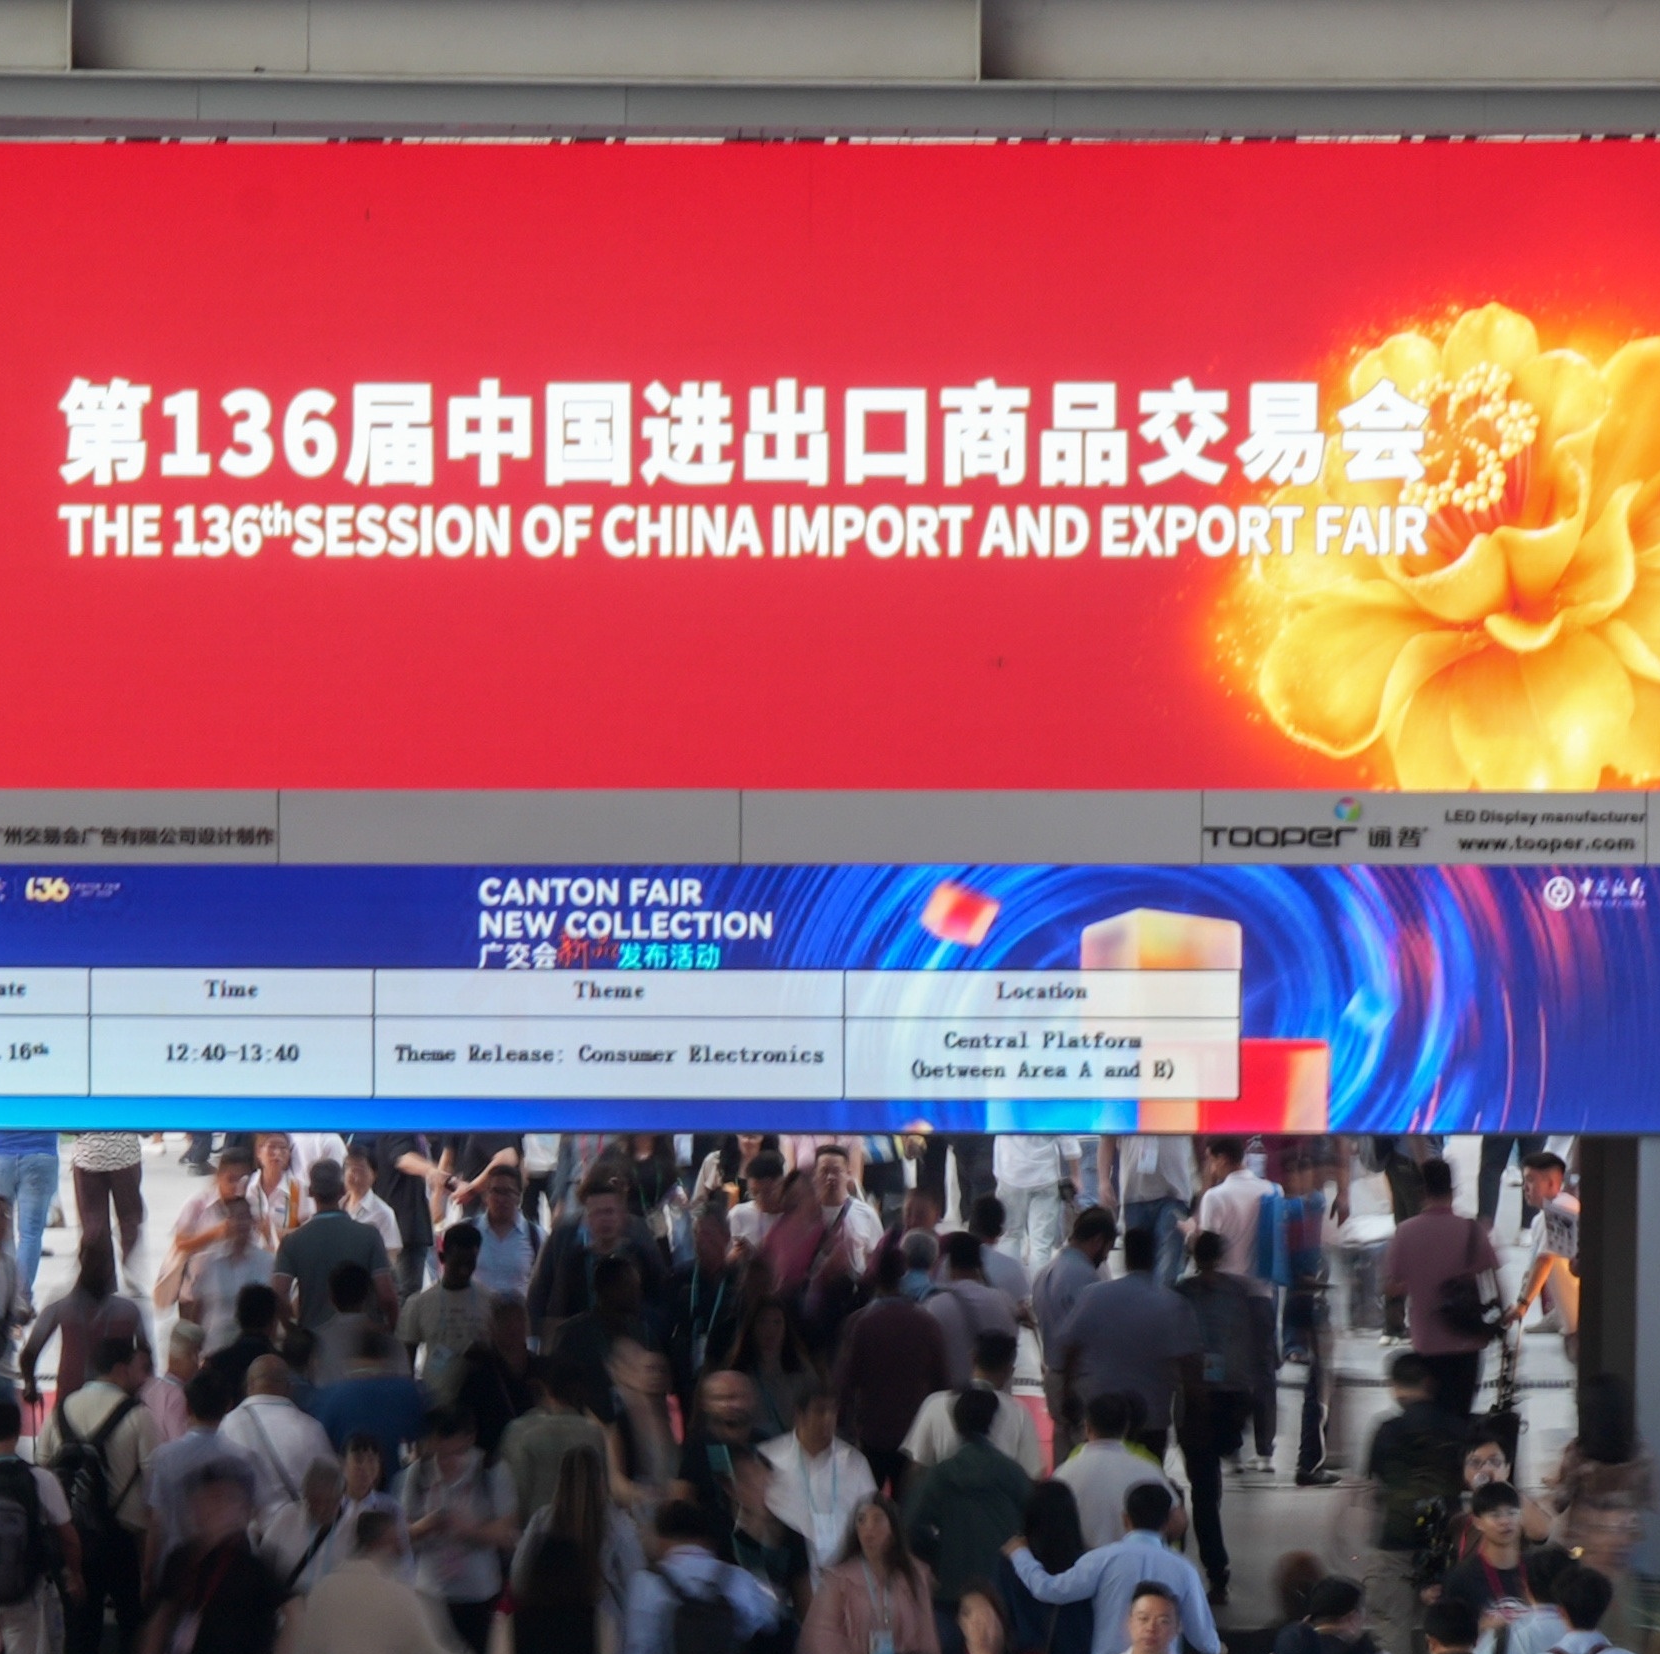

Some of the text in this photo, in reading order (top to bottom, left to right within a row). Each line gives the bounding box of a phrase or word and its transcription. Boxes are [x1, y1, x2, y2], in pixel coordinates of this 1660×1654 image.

[58, 377, 1431, 487] 第136届中国进出口商品交易会
[58, 505, 162, 557] THE
[521, 504, 593, 558] OF
[601, 504, 764, 558] CHINA
[772, 504, 972, 558] IMPORT
[979, 504, 1090, 558] AND
[1100, 504, 1304, 558] EXPORT
[1315, 504, 1429, 557] FAIR
[1444, 809, 1648, 828] LED Display manufacturer
[1457, 836, 1637, 856] www.tooper.com
[478, 877, 704, 907] CANTON FAIR
[478, 910, 775, 940] NEW COLLECTION
[204, 979, 259, 998] Time
[573, 980, 645, 999] Theme
[996, 981, 1087, 1001] Location
[942, 1031, 1143, 1050] Central Platform
[166, 1043, 301, 1063] 12:40-13:40
[394, 1044, 825, 1064] Theme Release: Consumer Electronics
[909, 1059, 1006, 1081] (between
[1017, 1061, 1068, 1079] Area
[1078, 1061, 1091, 1079] A
[1104, 1060, 1143, 1079] and
